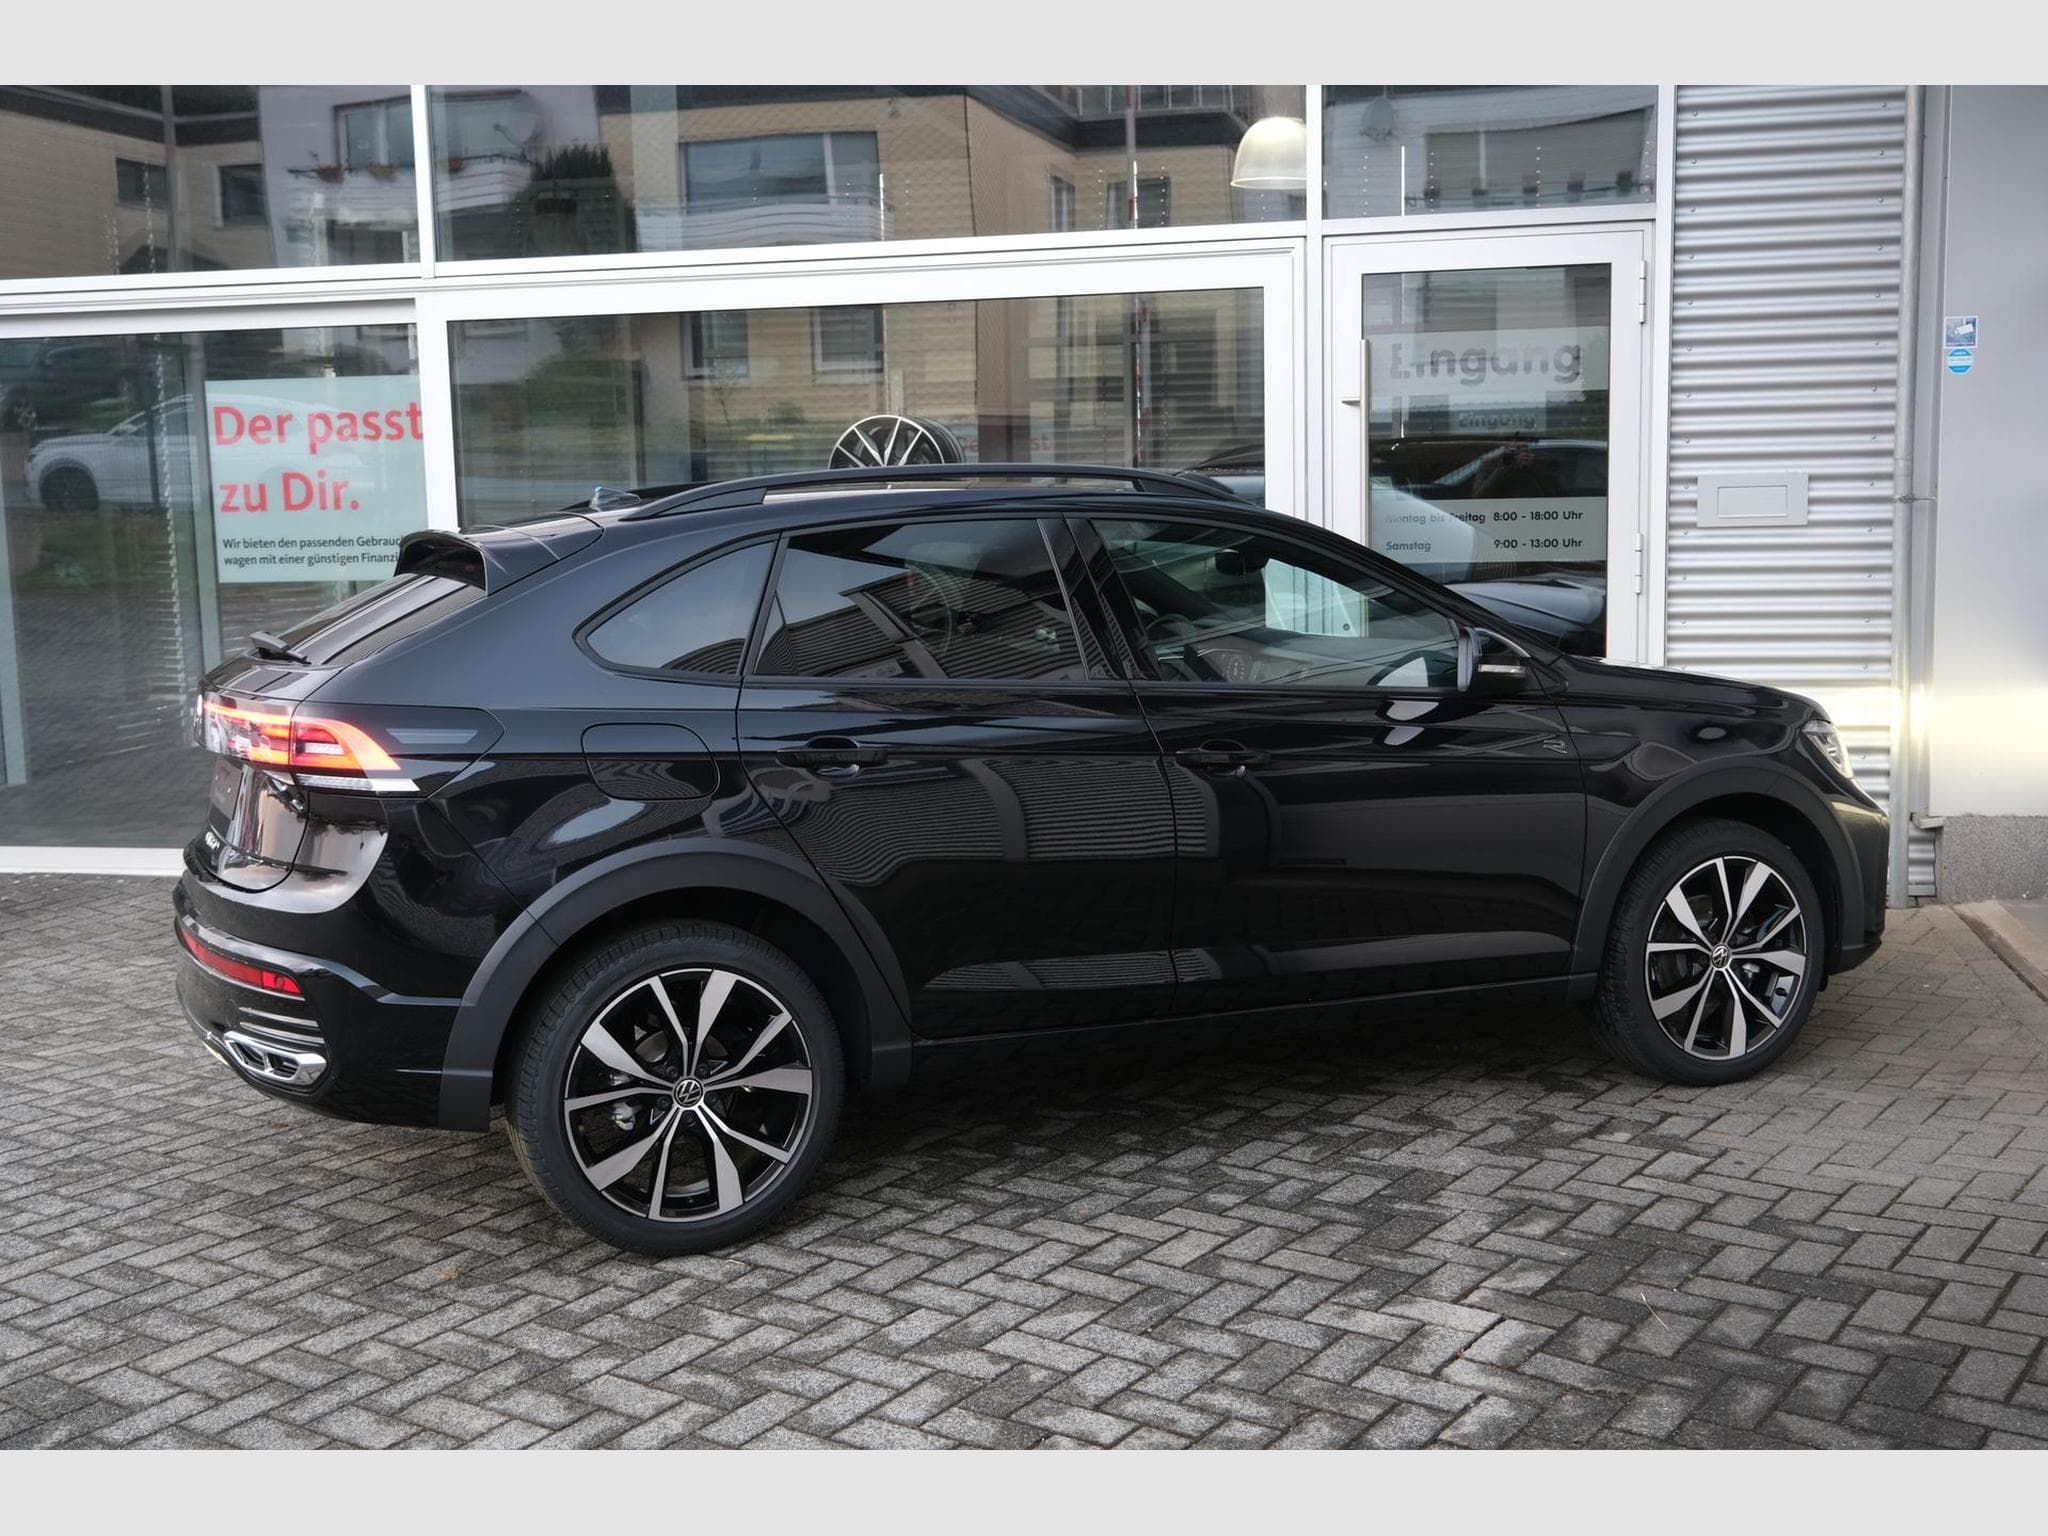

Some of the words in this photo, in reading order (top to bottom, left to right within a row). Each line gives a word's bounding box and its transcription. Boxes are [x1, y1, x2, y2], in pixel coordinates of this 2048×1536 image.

[213, 406, 293, 445] Der
[307, 402, 424, 455] passt
[219, 482, 267, 512] zu
[281, 470, 360, 511] Dir.
[1385, 513, 1426, 525] ntag
[1450, 512, 1486, 524] eitag
[1493, 511, 1518, 521] 8:00
[1530, 510, 1559, 520] 18:00
[1563, 509, 1584, 520] Uhr
[223, 538, 241, 549] Wir
[243, 538, 276, 549] bieten
[278, 538, 298, 548] den
[300, 537, 354, 550] passenden
[356, 536, 403, 547] Gebrauc
[1385, 541, 1432, 552] Samstag
[1494, 539, 1518, 549] 9:00
[1530, 538, 1559, 548] 13:00
[1563, 537, 1583, 548] Uhr
[224, 556, 258, 568] wagen
[259, 554, 277, 565] mit
[279, 554, 306, 564] einer
[307, 553, 360, 567] günstigen
